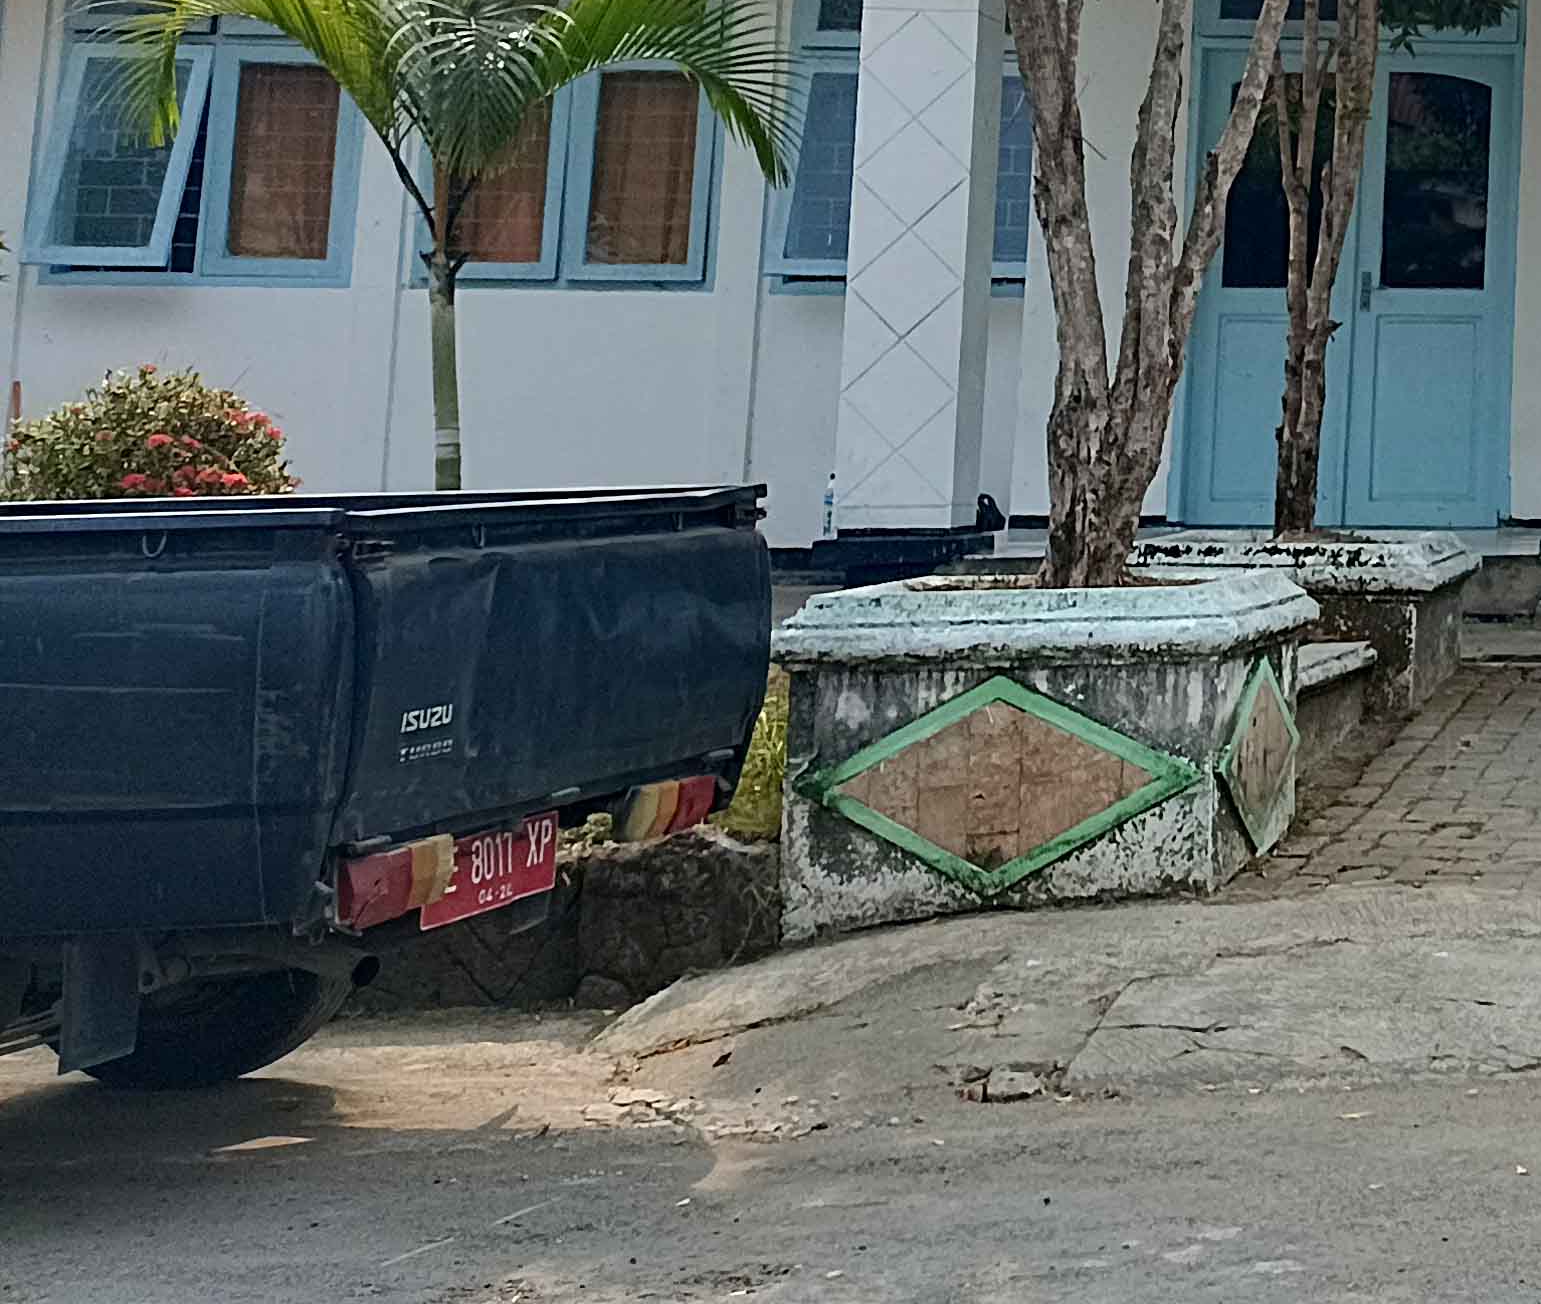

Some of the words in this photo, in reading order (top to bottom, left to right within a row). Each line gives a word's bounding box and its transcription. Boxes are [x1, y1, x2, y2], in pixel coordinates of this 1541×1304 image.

[400, 703, 454, 733] ISUZU
[471, 831, 513, 884] 8017
[526, 818, 553, 868] XP
